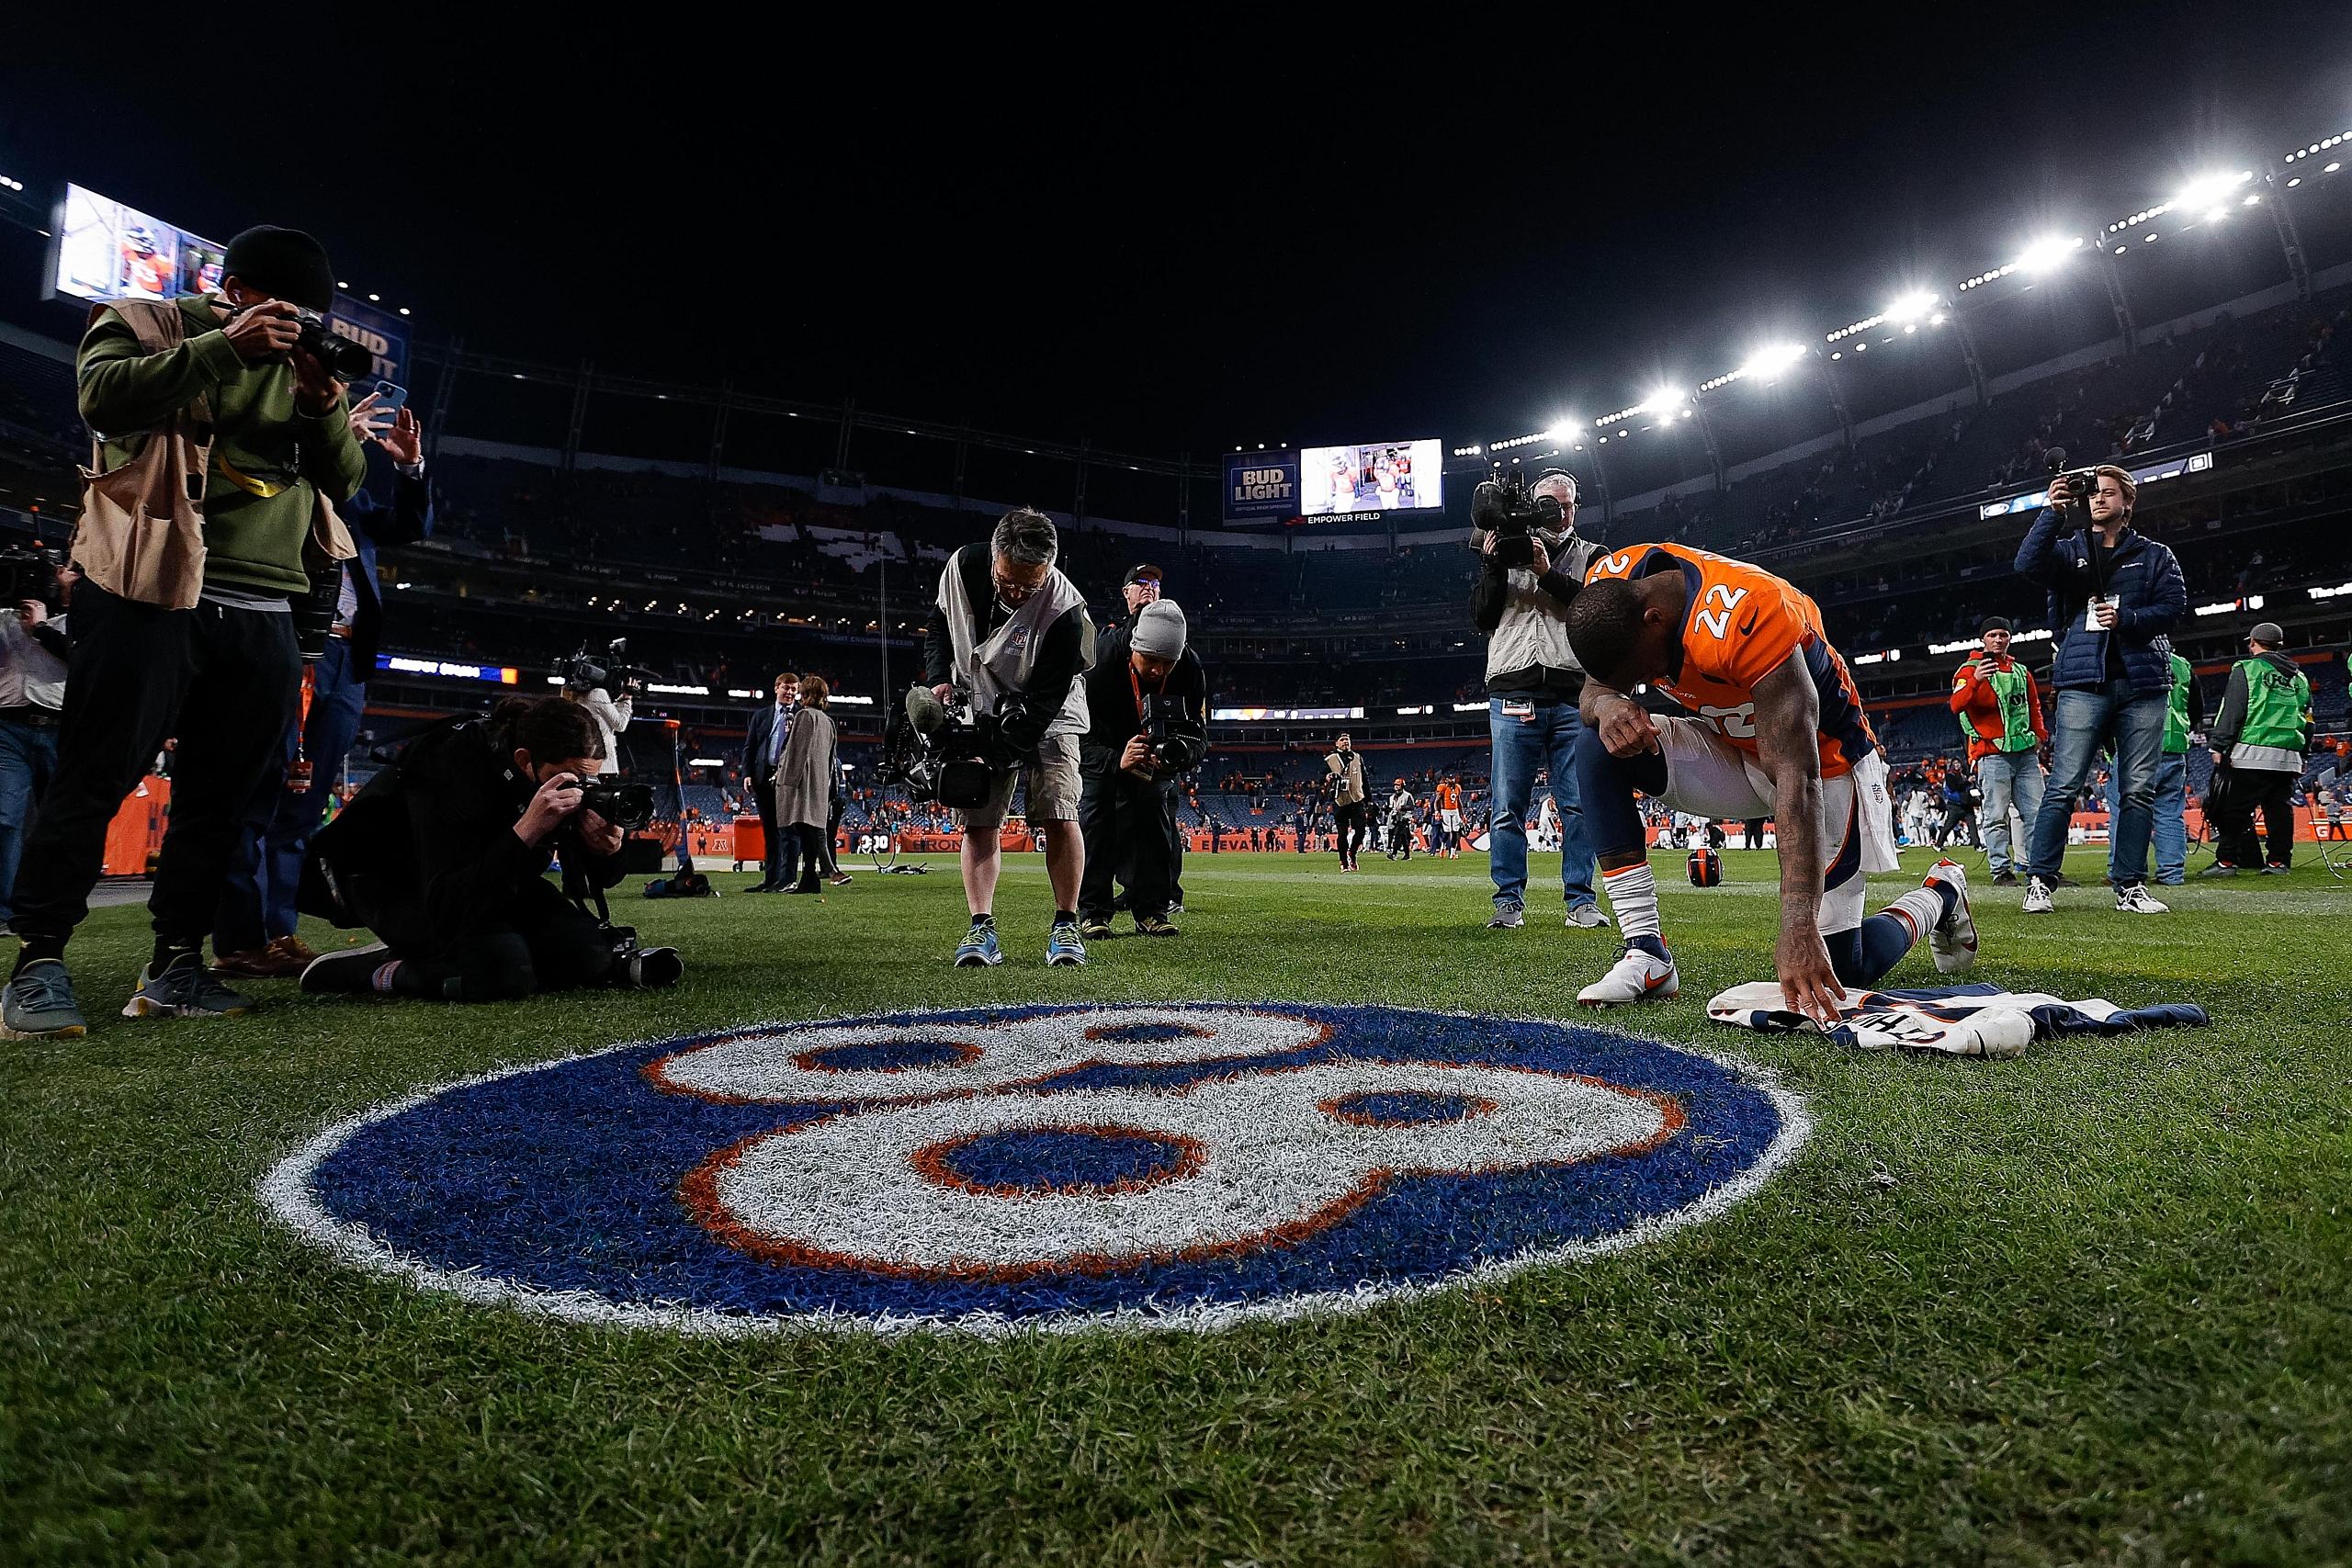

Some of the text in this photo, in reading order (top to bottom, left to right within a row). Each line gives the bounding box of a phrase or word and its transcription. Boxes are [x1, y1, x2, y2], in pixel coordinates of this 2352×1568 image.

[1242, 468, 1284, 486] BUD
[1234, 482, 1293, 502] LIGHT
[1307, 512, 1381, 525] EMPOWER FIELD
[1589, 554, 1631, 584] 2
[2308, 587, 2335, 600] The
[1693, 583, 1749, 640] 22
[1012, 633, 1027, 644] NFL
[1928, 644, 1946, 654] The
[1450, 793, 1457, 804] 9
[642, 1005, 1687, 1284] 88
